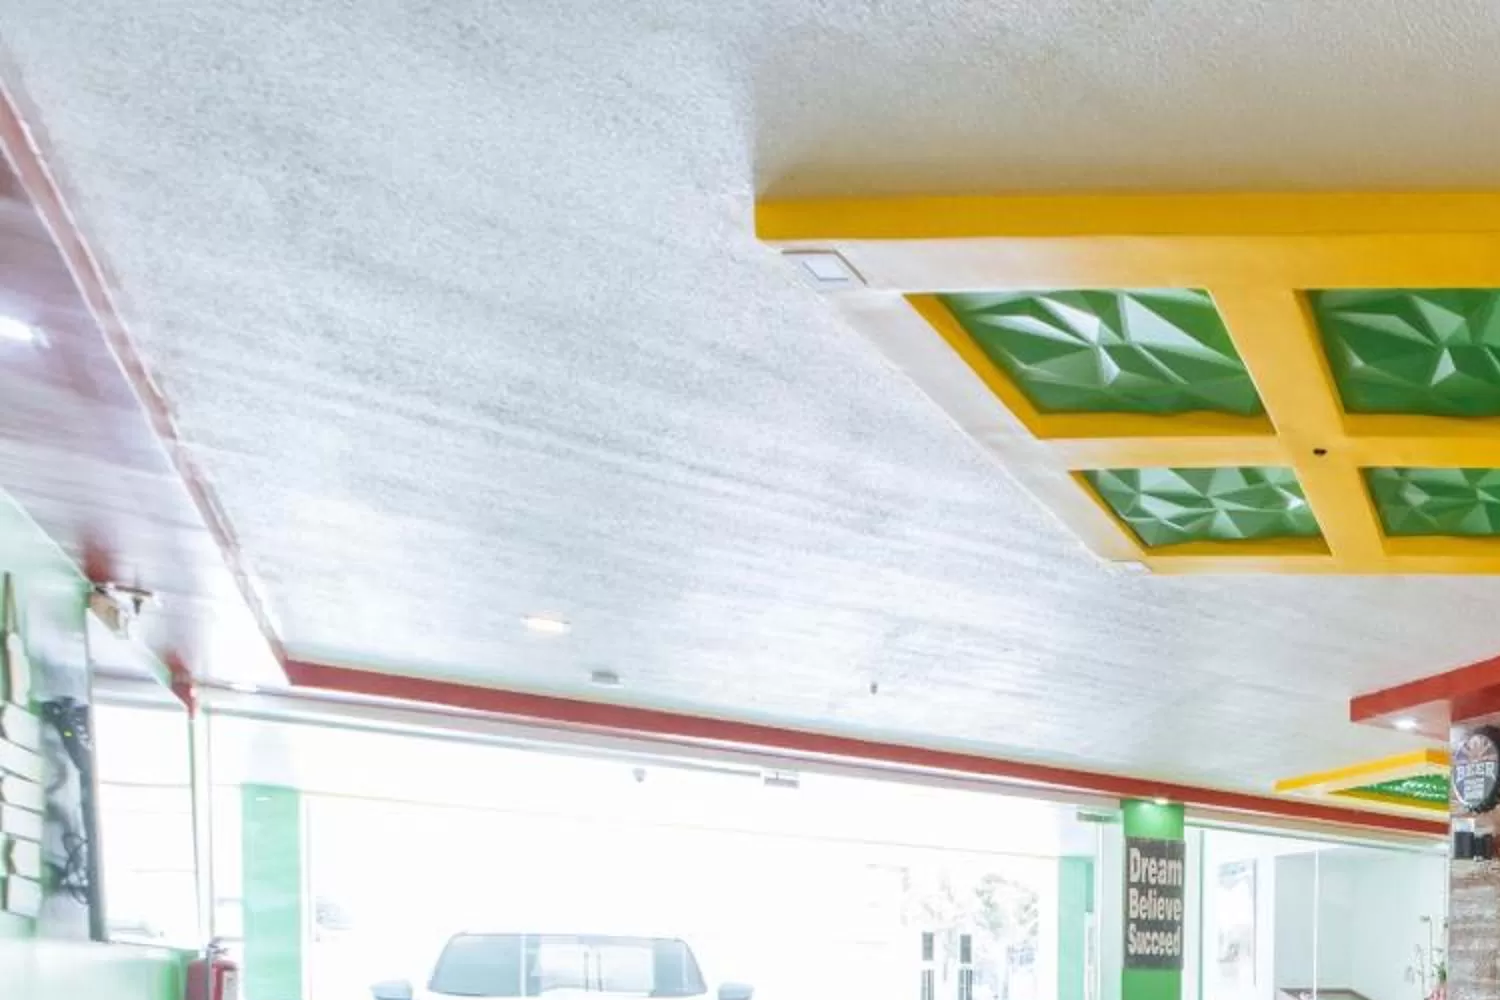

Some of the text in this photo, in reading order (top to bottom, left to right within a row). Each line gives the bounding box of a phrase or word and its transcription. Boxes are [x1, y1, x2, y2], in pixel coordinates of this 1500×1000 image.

[1456, 761, 1496, 780] BEER
[1129, 847, 1183, 885] Dream
[1128, 888, 1181, 920] Believe
[1128, 923, 1181, 956] Succeed
